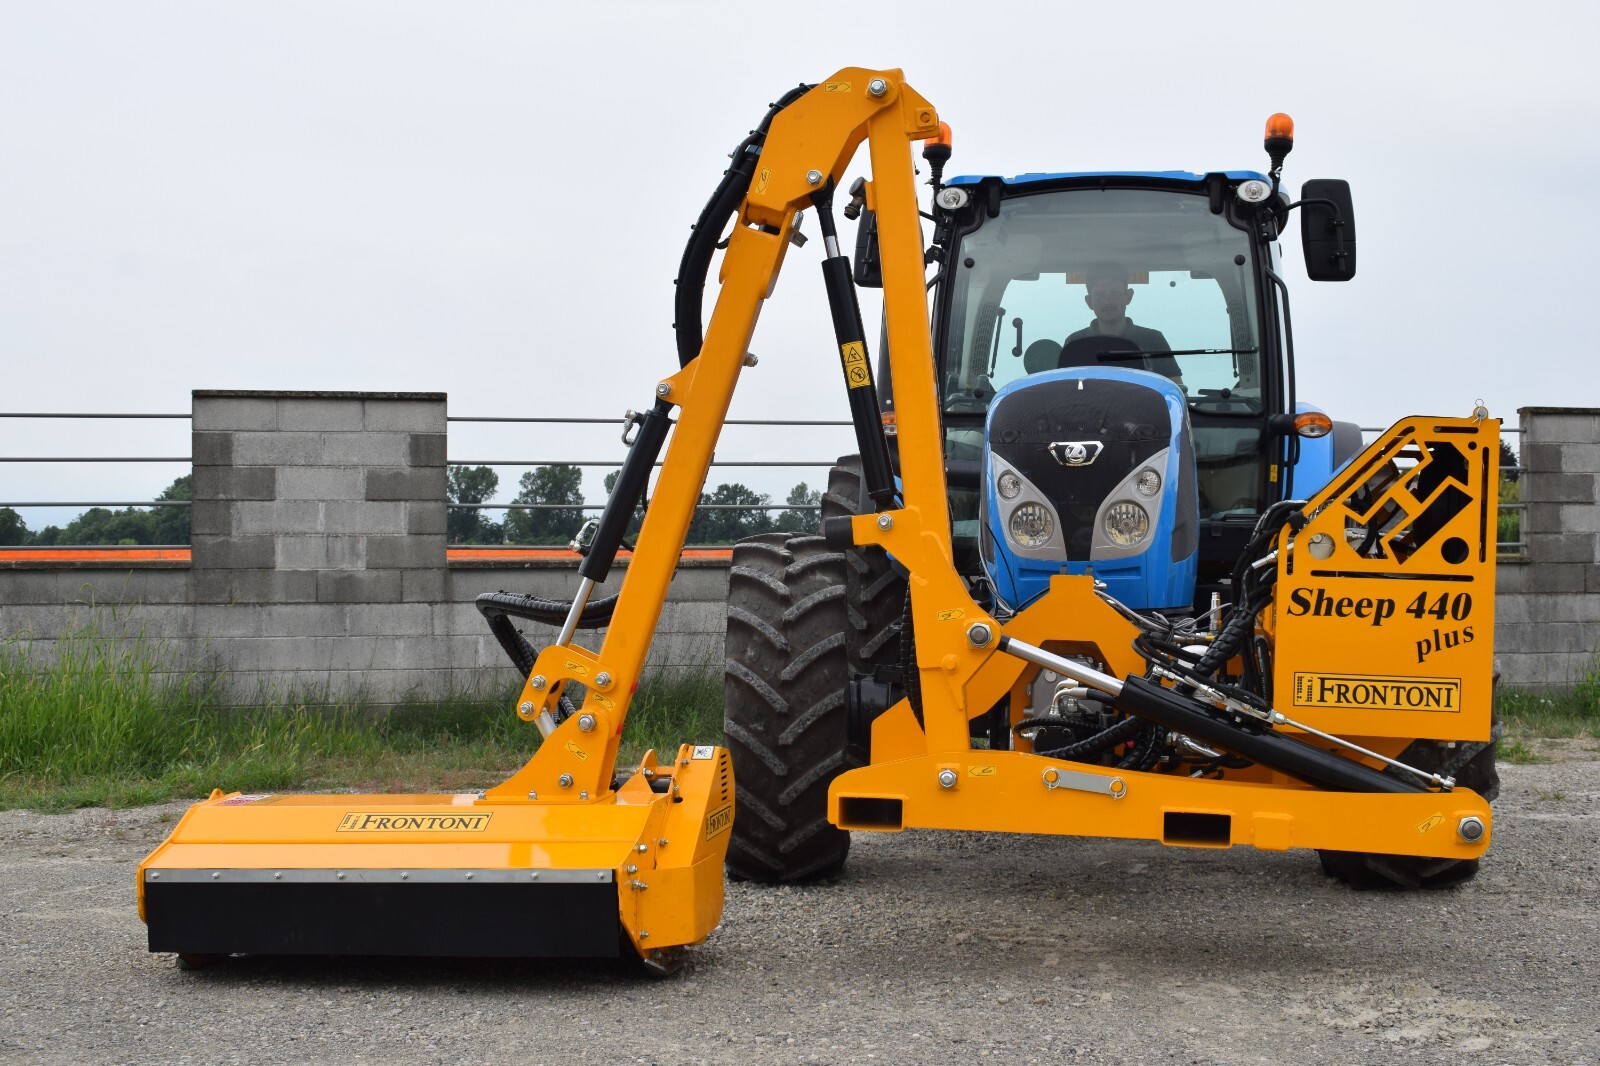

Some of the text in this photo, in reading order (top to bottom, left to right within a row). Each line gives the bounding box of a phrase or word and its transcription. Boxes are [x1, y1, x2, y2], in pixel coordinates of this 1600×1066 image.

[1287, 587, 1472, 626] Sheep 440
[1416, 625, 1475, 663] plus
[1317, 677, 1458, 708] FRONTONI
[358, 814, 490, 830] FRONTONI
